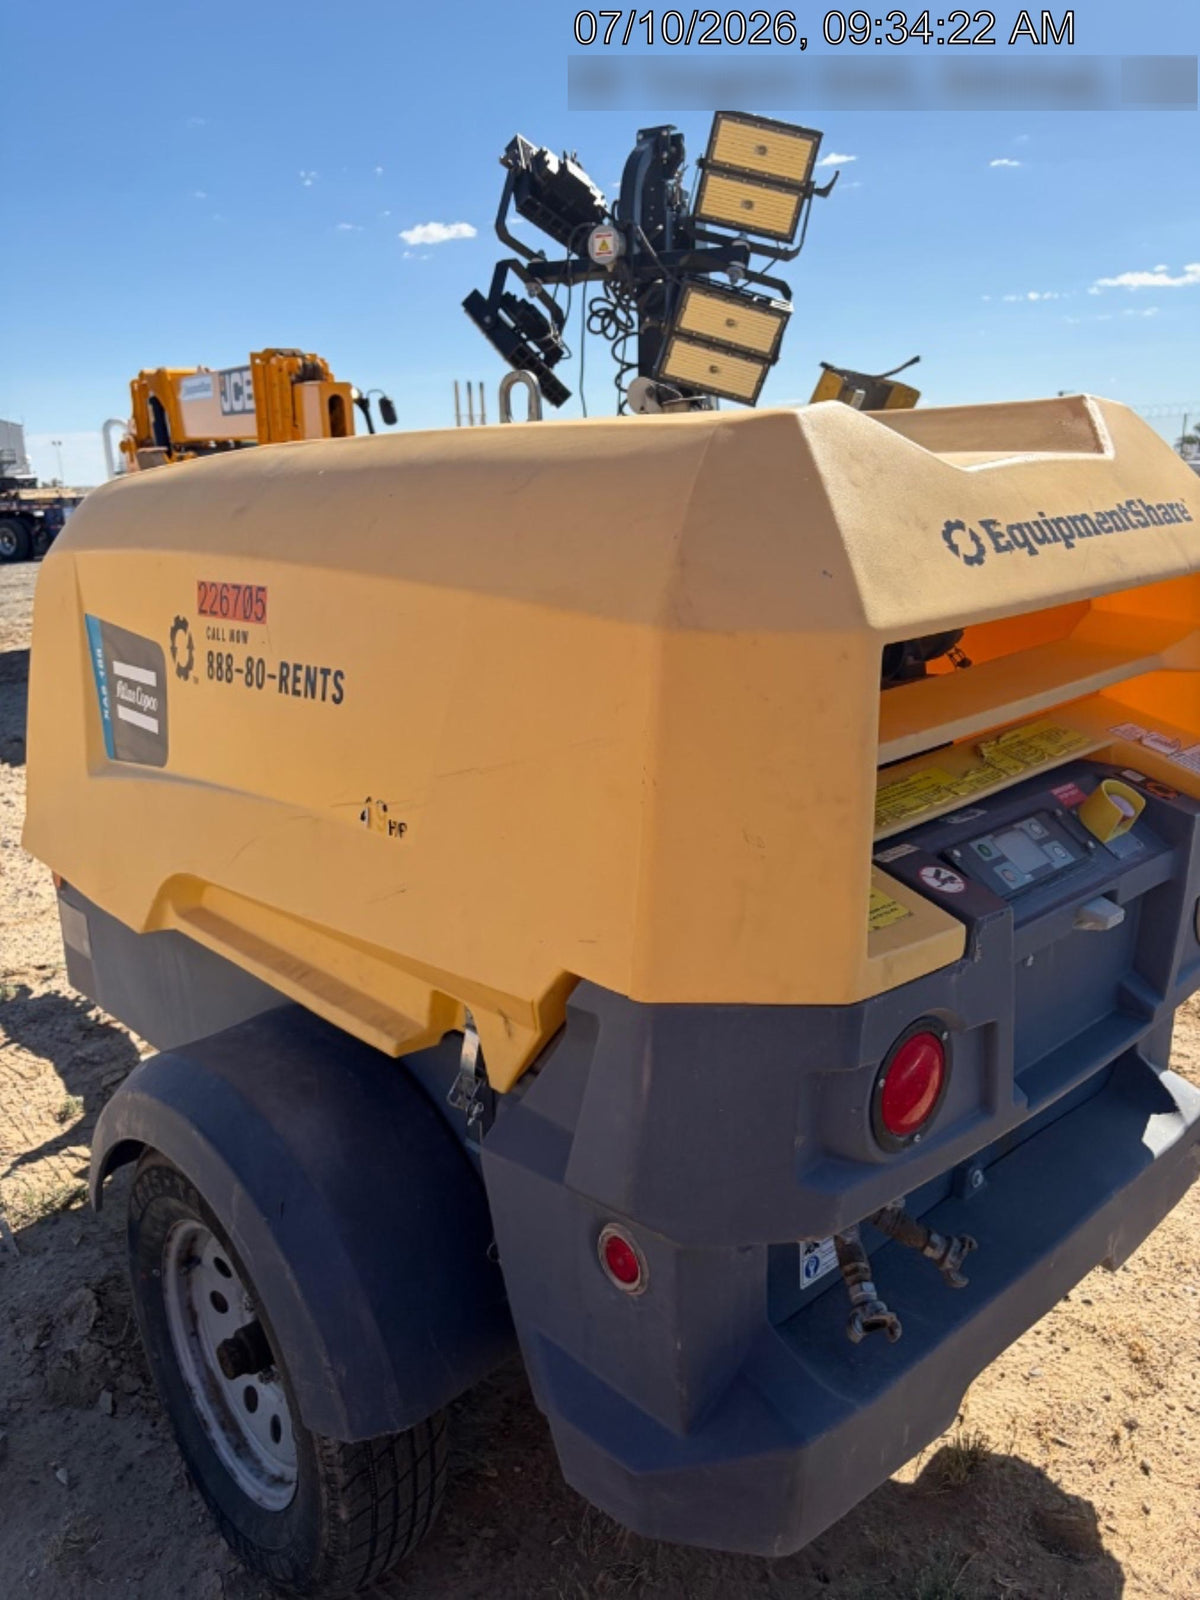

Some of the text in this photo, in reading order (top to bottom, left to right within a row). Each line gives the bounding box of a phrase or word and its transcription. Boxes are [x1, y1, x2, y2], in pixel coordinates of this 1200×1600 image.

[978, 498, 1193, 556] EquipmentShare
[198, 581, 266, 621] 226705
[205, 625, 249, 645] CALL NOW
[206, 650, 345, 705] 888-80-RENTS
